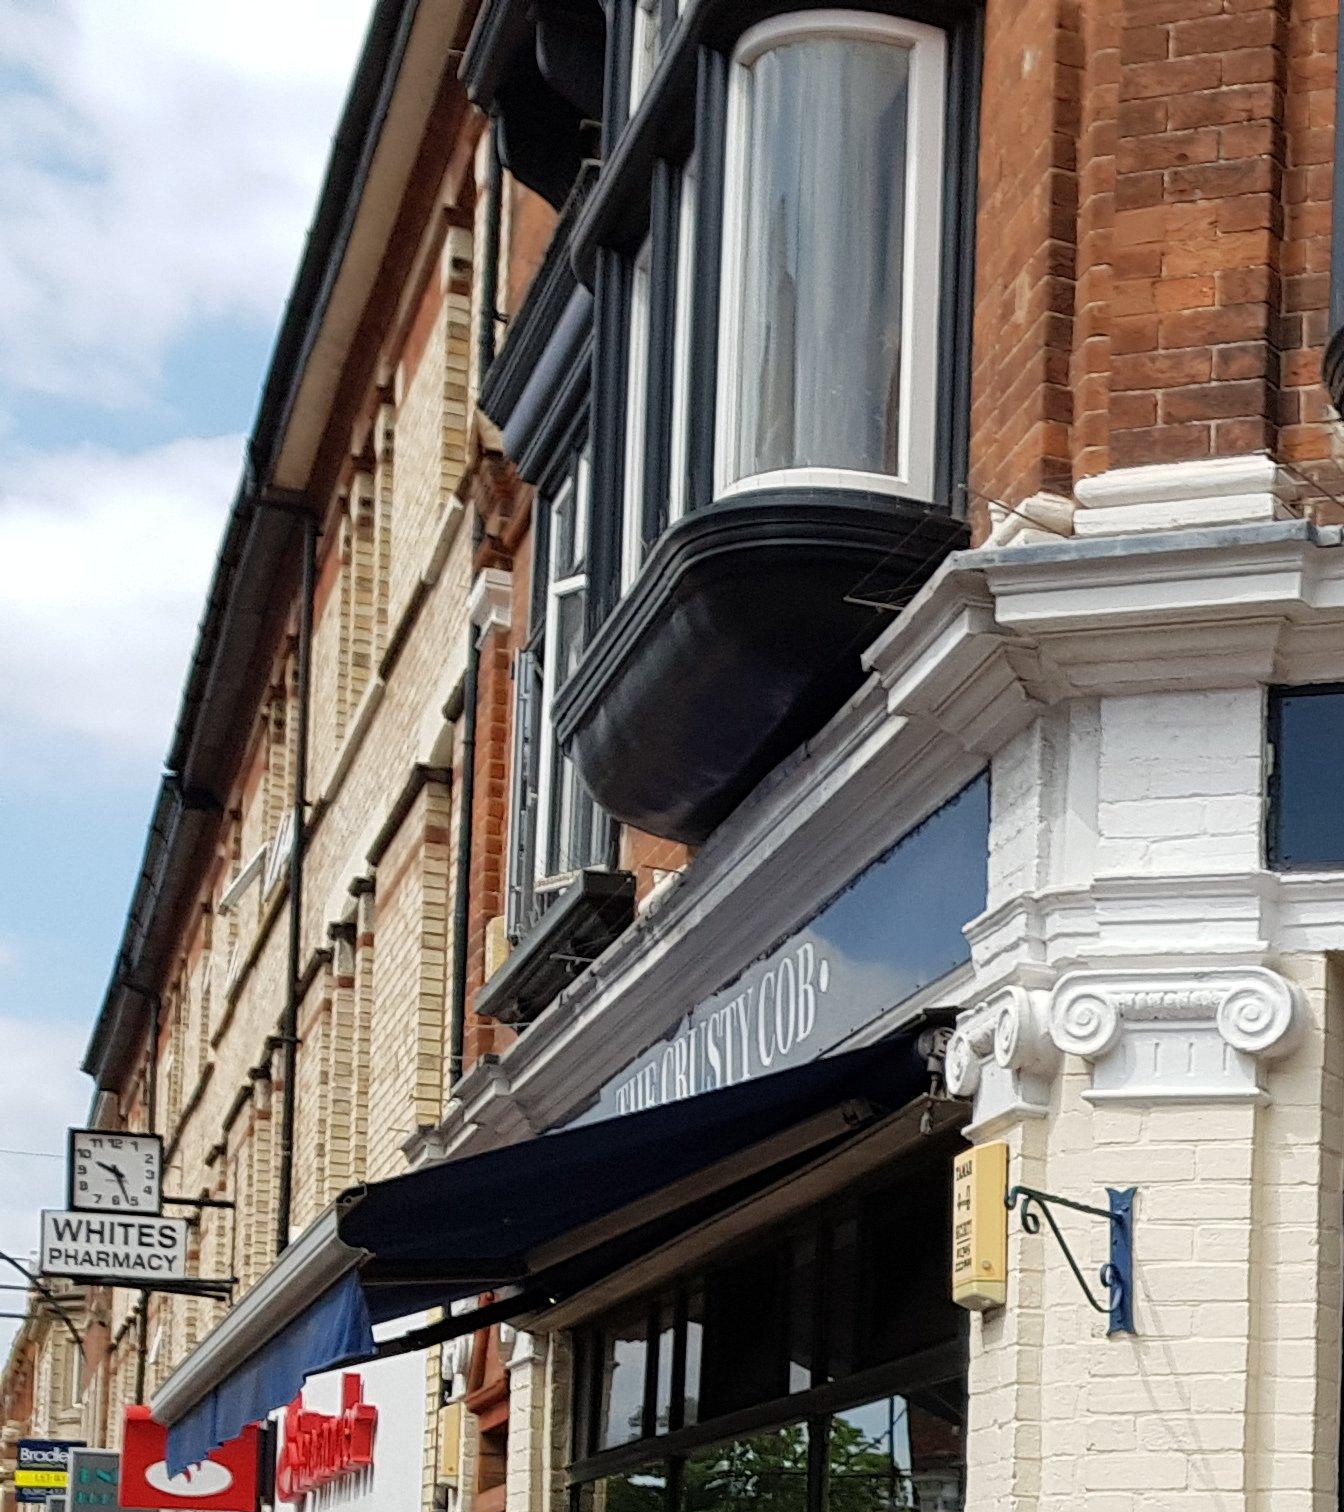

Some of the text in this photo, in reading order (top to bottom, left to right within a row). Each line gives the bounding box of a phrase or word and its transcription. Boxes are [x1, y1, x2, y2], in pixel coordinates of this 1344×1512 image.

[616, 943, 815, 1115] THE CRUSTY COB
[52, 1218, 177, 1249] WHITES
[48, 1248, 177, 1272] PHARMACY
[21, 1447, 69, 1462] Bradle
